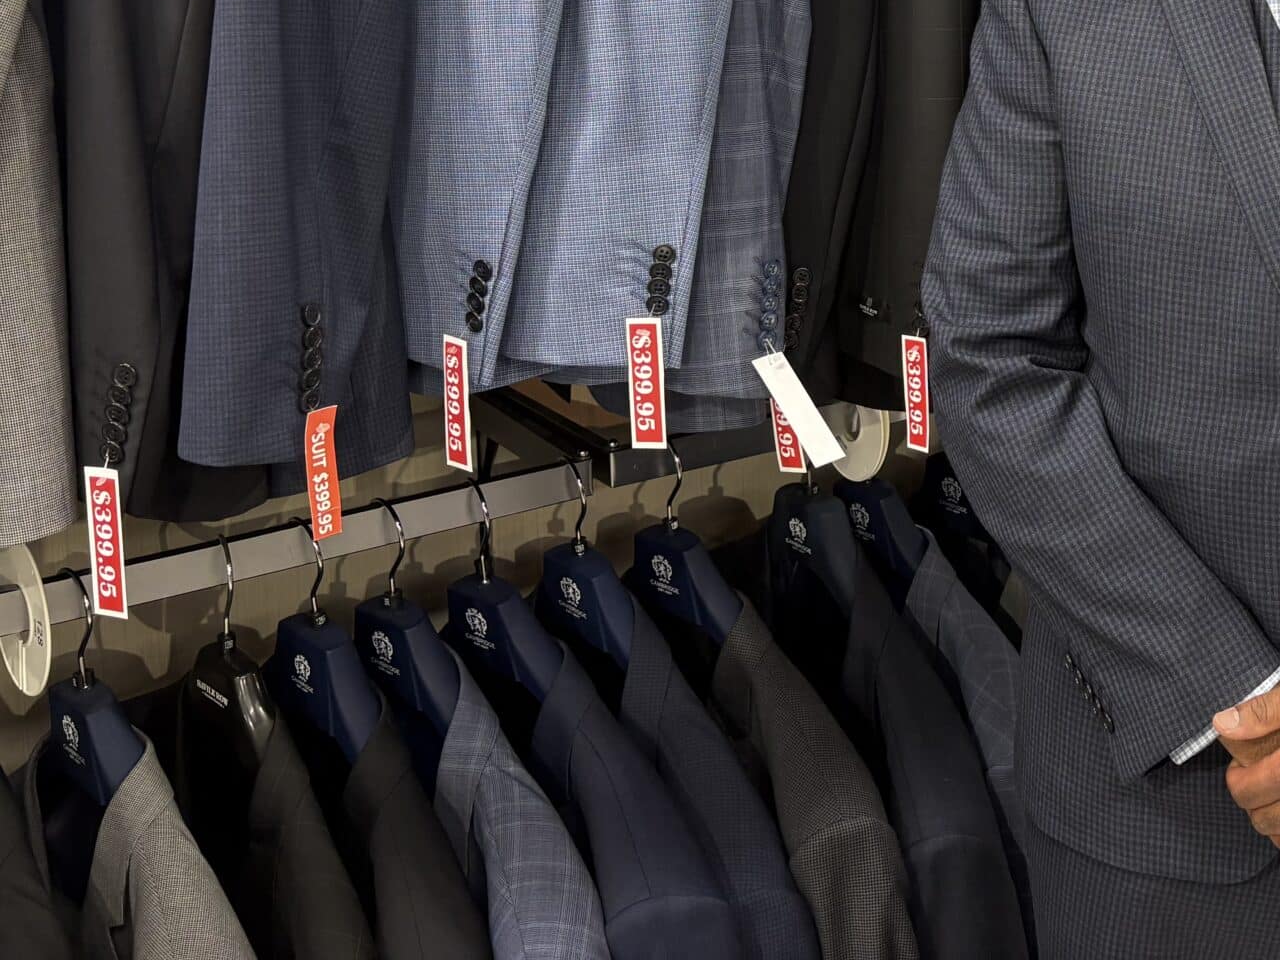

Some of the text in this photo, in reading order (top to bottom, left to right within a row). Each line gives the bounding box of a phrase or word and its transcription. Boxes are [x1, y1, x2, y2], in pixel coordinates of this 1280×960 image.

[446, 354, 462, 452] $399.95
[632, 335, 656, 431] $399.95
[907, 348, 924, 436] $399.95
[311, 433, 333, 535] SUIT $399.95
[93, 490, 117, 598] $399.95
